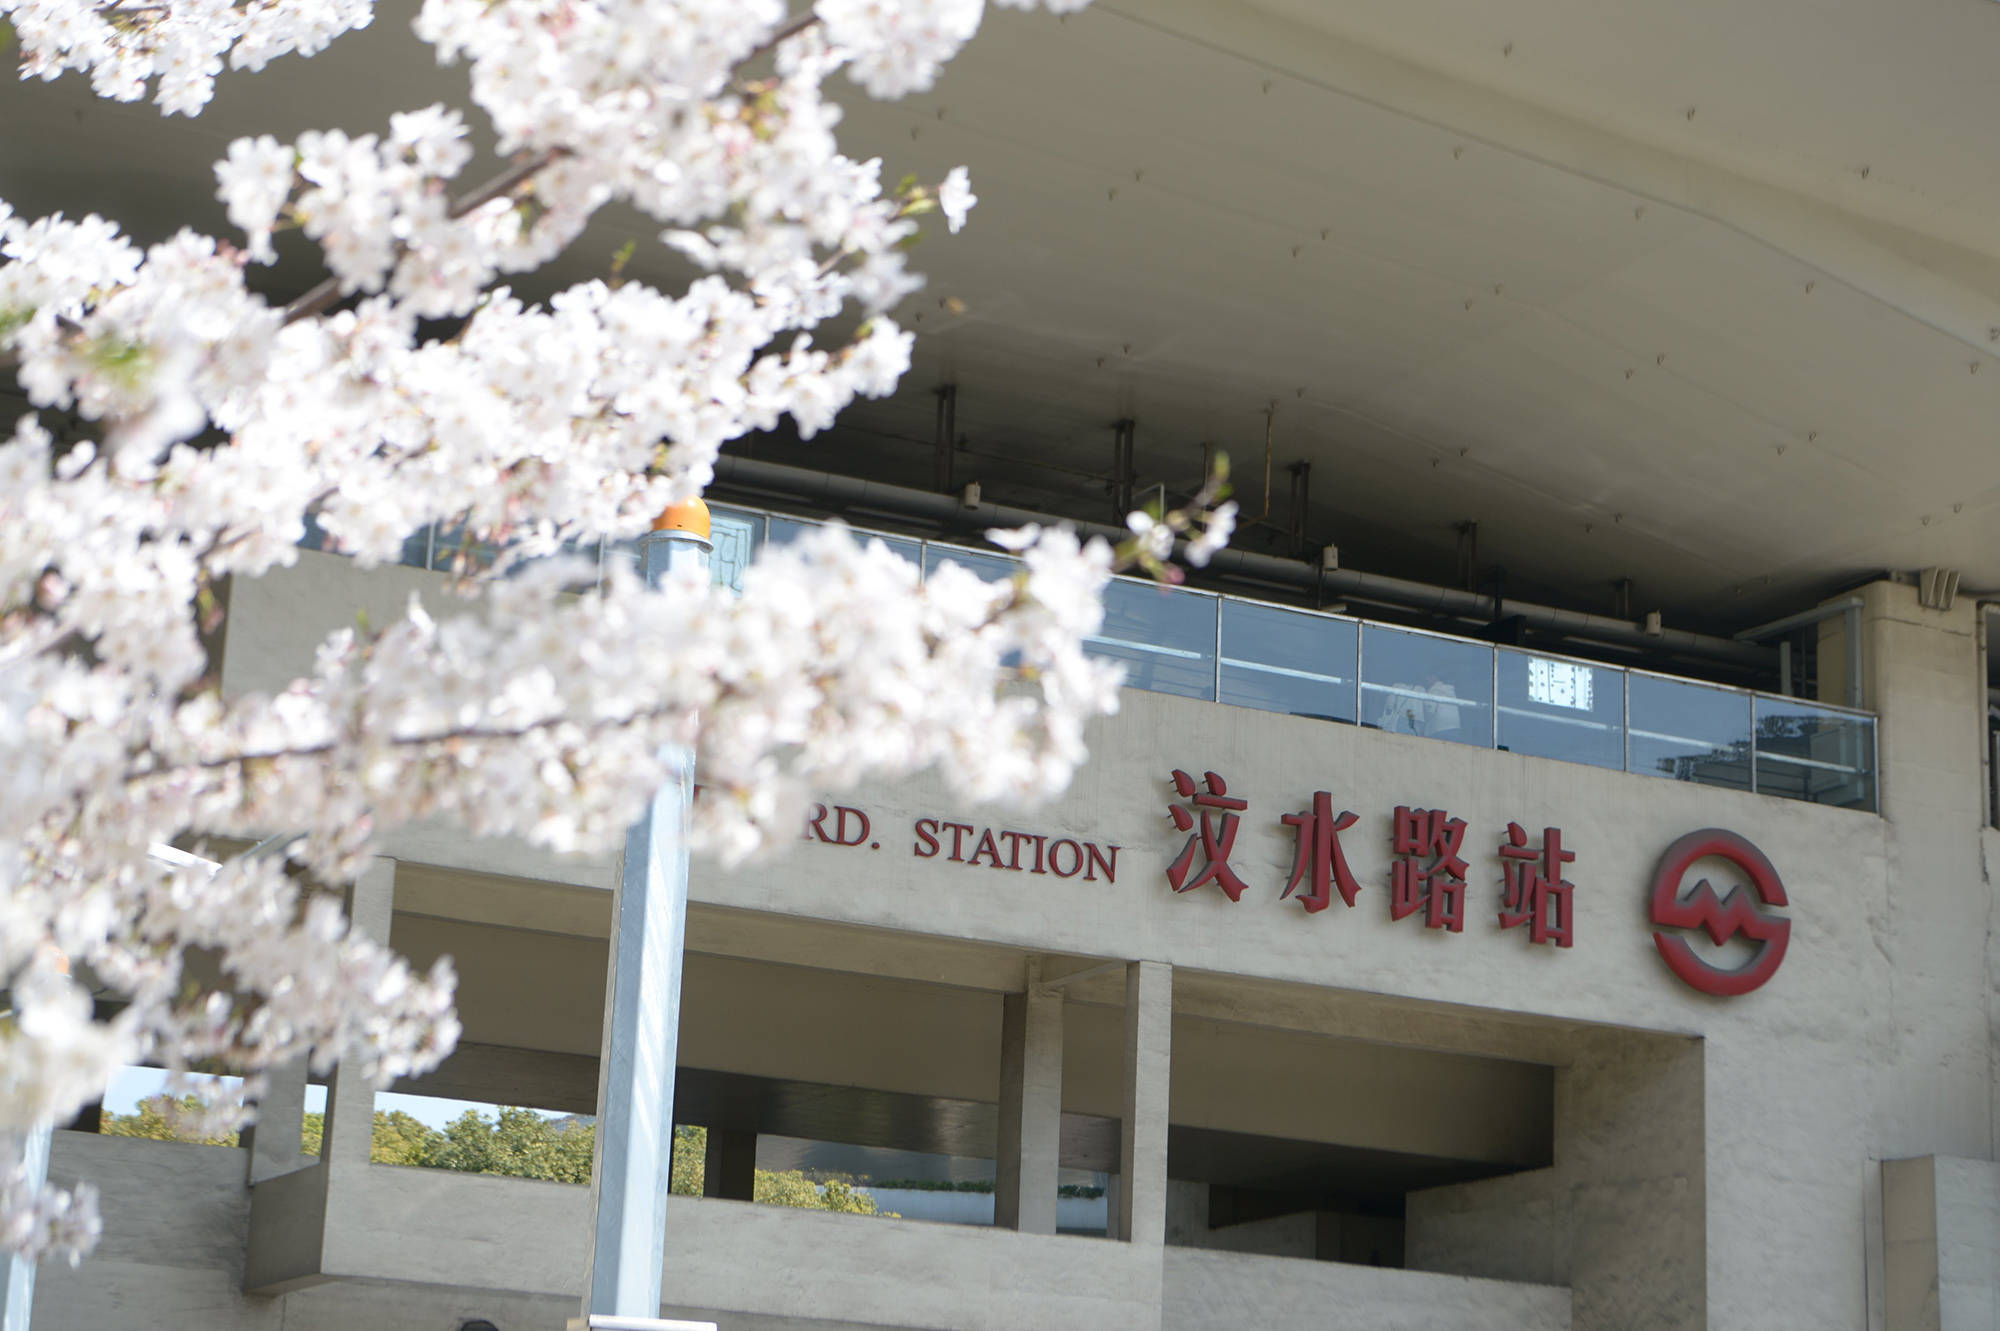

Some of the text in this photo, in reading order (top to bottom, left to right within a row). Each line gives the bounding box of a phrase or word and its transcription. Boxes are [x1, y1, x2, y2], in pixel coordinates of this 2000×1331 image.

[913, 817, 1121, 883] STATION
[1167, 769, 1576, 948] 汶水路站
